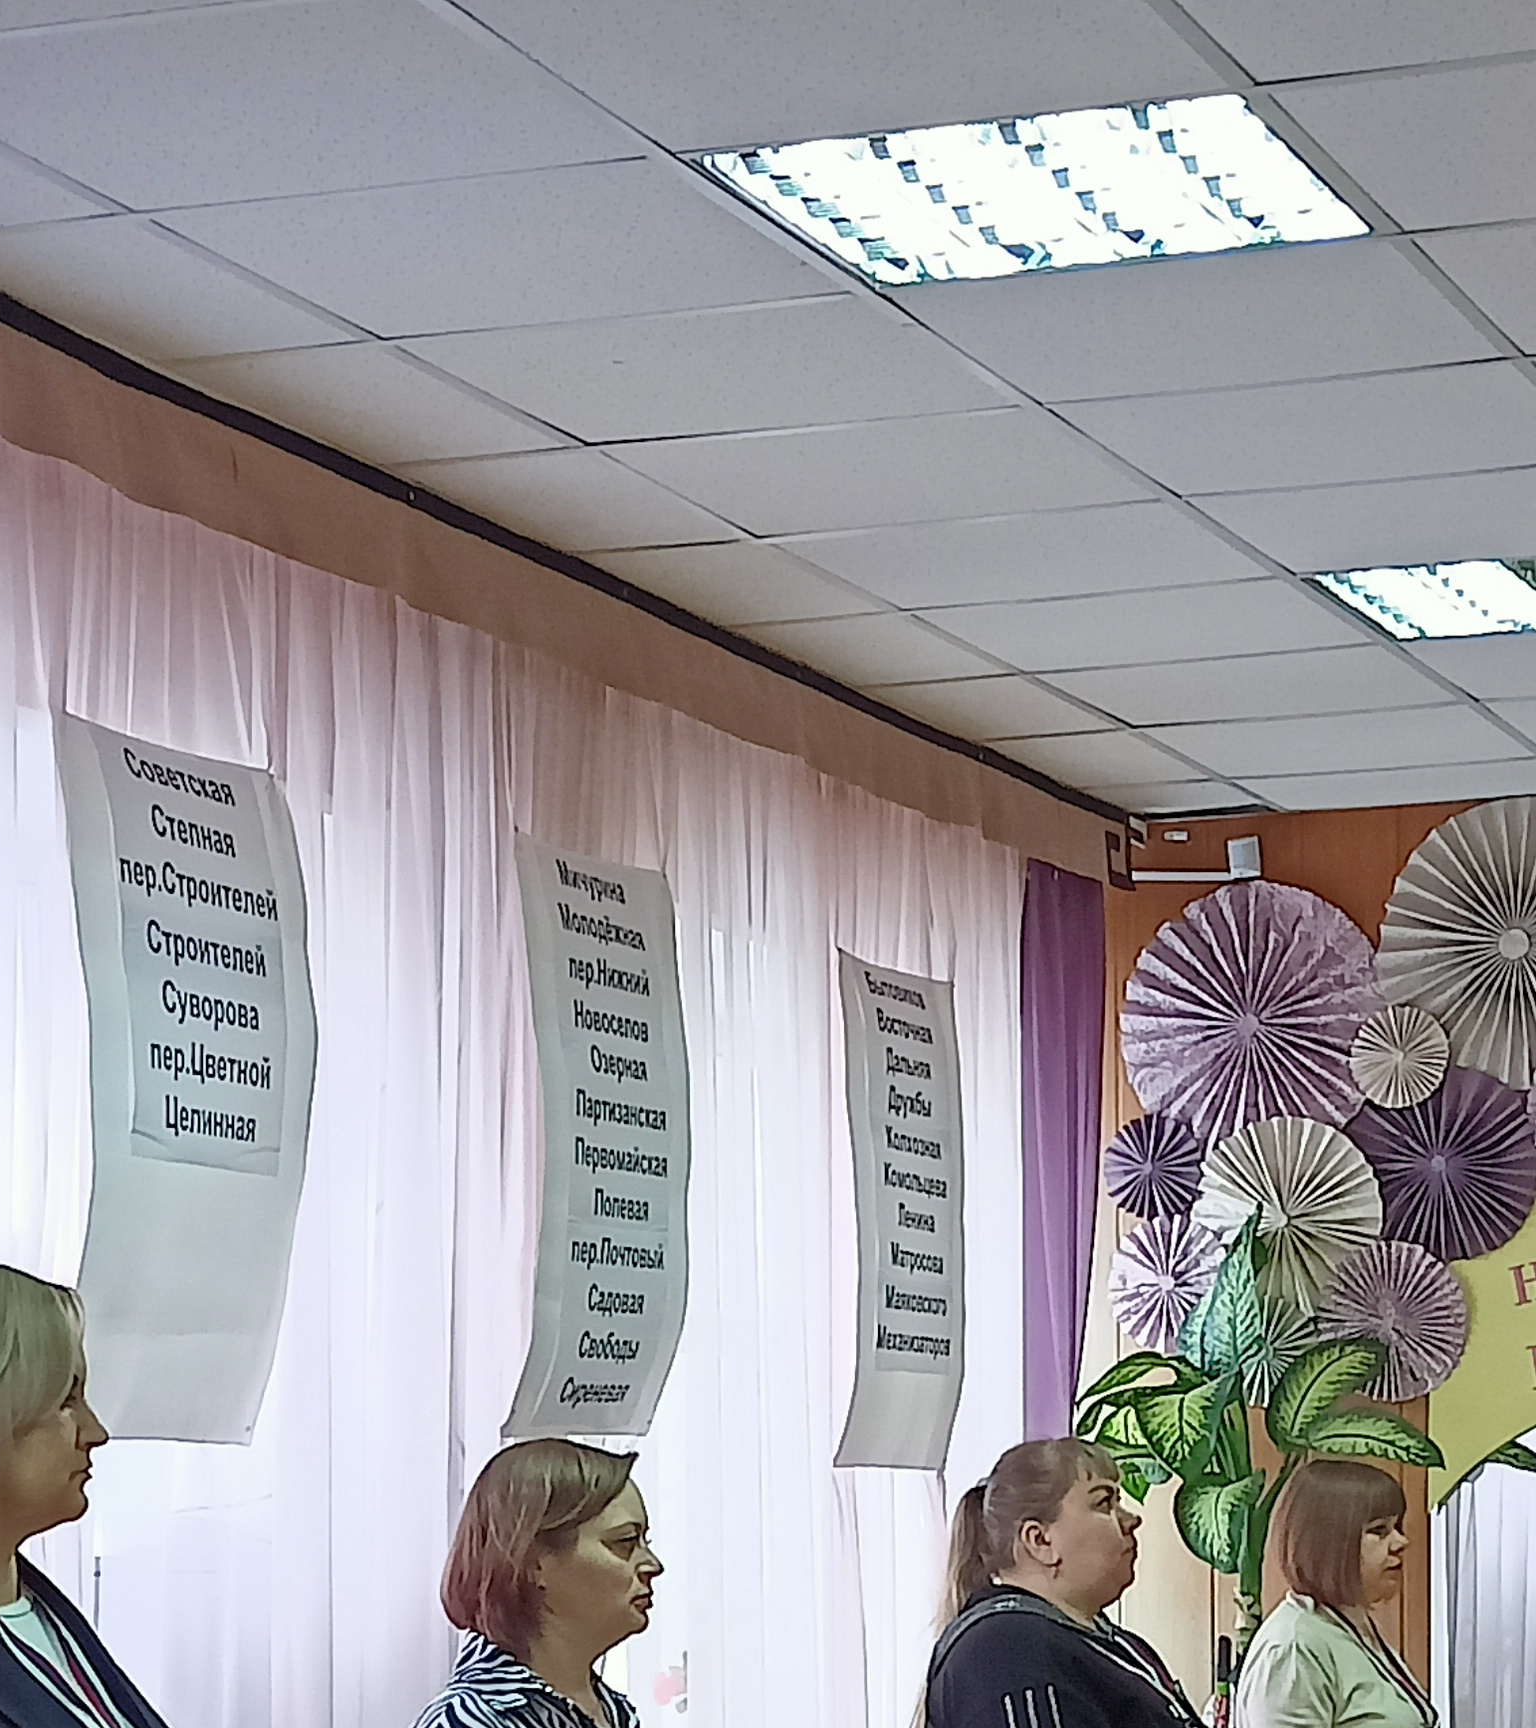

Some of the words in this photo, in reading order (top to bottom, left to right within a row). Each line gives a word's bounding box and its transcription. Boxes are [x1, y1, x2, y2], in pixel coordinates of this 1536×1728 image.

[123, 747, 236, 807] Советская
[151, 804, 236, 858] Степная
[119, 857, 278, 921] пер.Строителей
[146, 919, 267, 978] Строителей
[162, 979, 260, 1032] Суворова
[573, 999, 649, 1044] Новоселов
[150, 1041, 271, 1090] пер.Цветной
[590, 1044, 648, 1083] Озерная
[164, 1094, 257, 1143] Целинная
[575, 1088, 667, 1132] Партизанская
[574, 1136, 668, 1178] Первомайская
[593, 1188, 649, 1222] Полевая
[571, 1236, 665, 1270] пер.Почтовый
[587, 1283, 644, 1317] Садовая
[578, 1331, 640, 1365] Свободы
